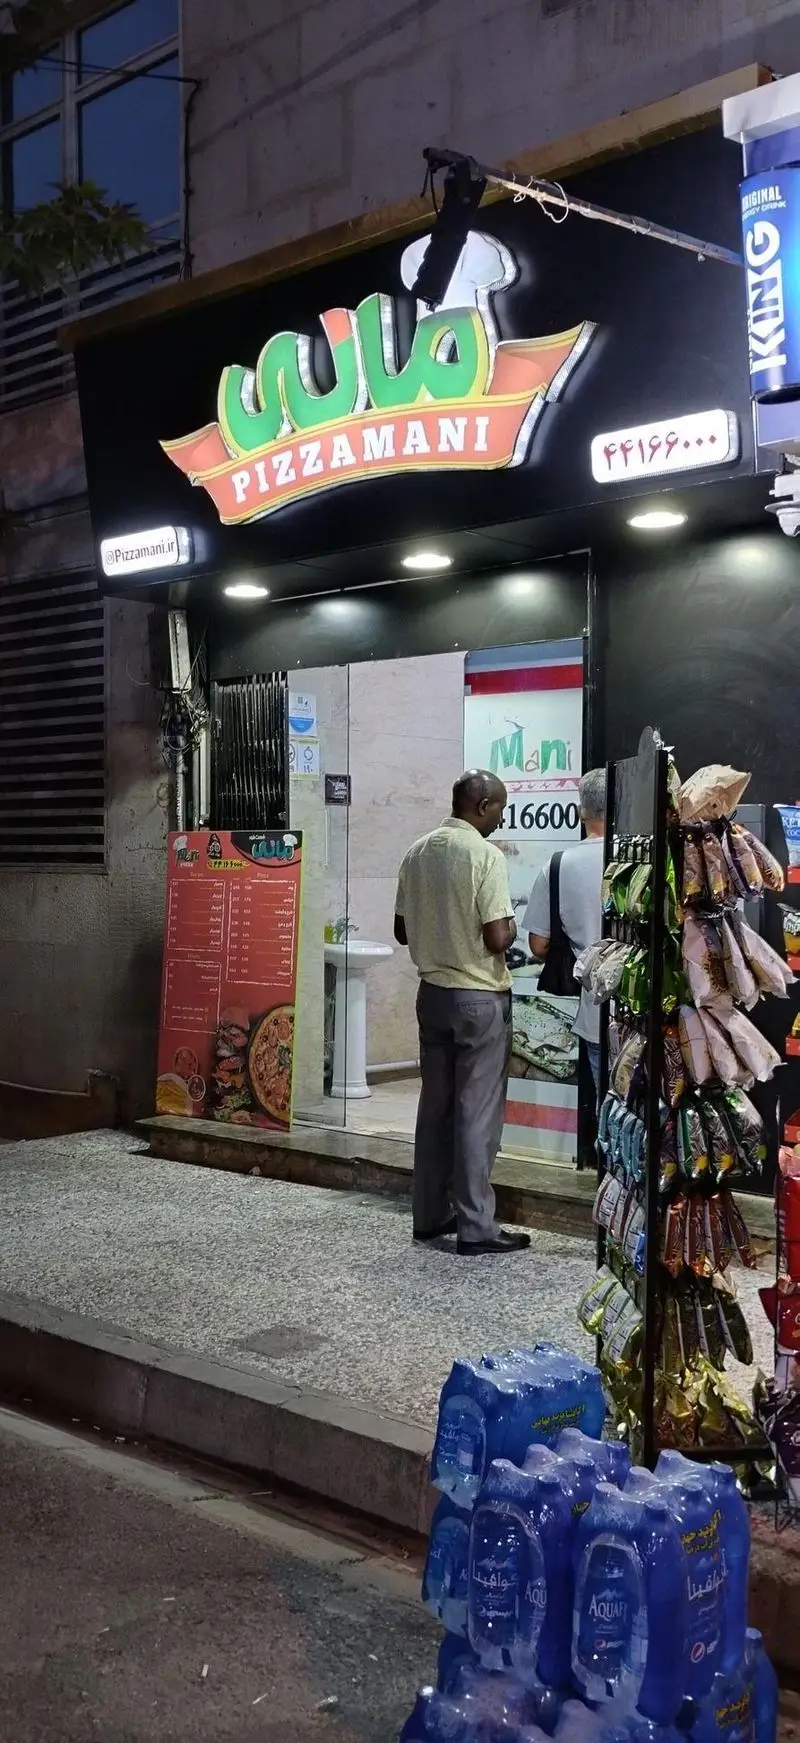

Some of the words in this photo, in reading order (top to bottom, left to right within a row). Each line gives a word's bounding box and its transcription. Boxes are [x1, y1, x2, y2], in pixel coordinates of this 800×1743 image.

[746, 220, 787, 375] KING
[219, 293, 485, 453] مانی
[232, 416, 490, 503] PIZZAMANI
[603, 431, 717, 470] ۴۴۱۶۶۰۰۰
[488, 729, 571, 777] Mani
